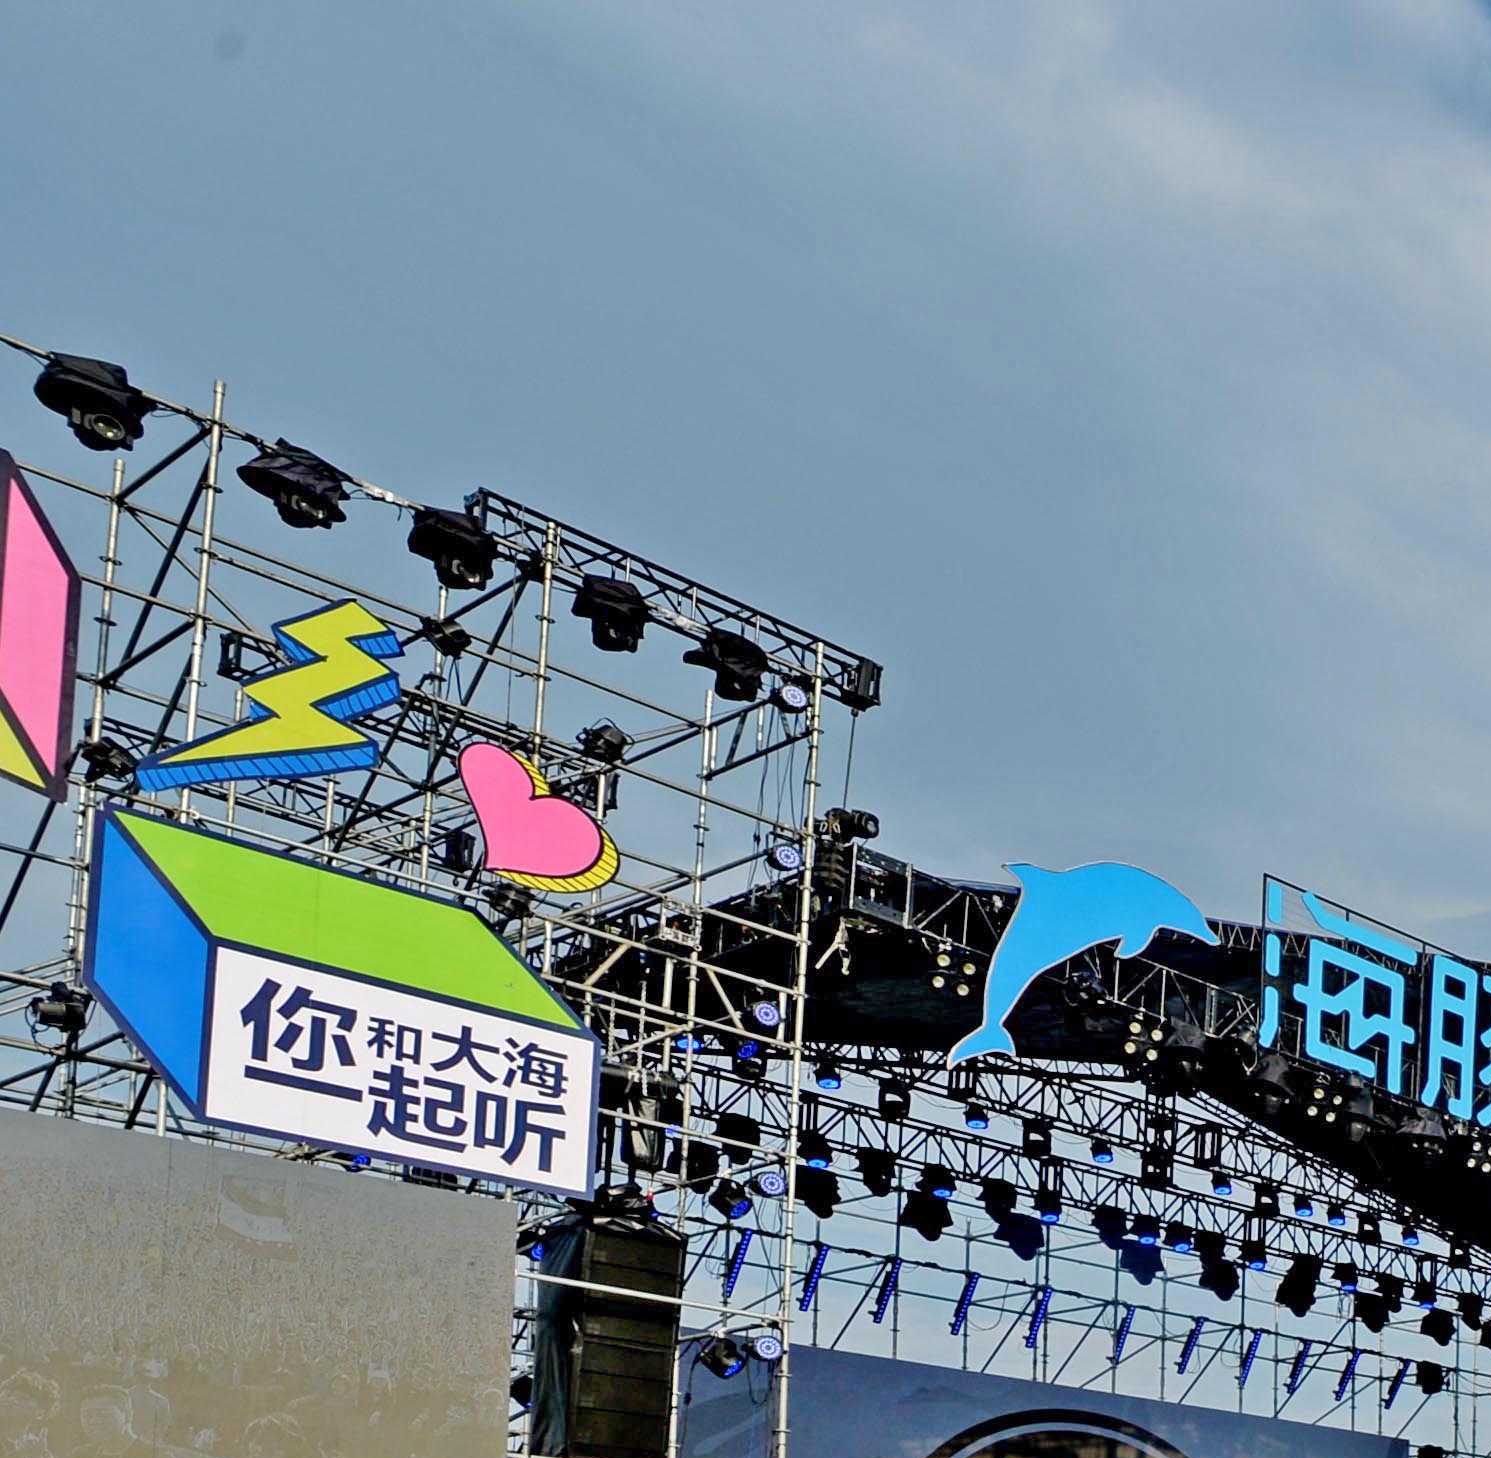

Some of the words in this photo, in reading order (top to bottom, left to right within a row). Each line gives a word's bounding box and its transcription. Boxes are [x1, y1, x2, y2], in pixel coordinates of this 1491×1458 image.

[241, 978, 567, 1098] 你和大海
[244, 1064, 565, 1173] 一起听
